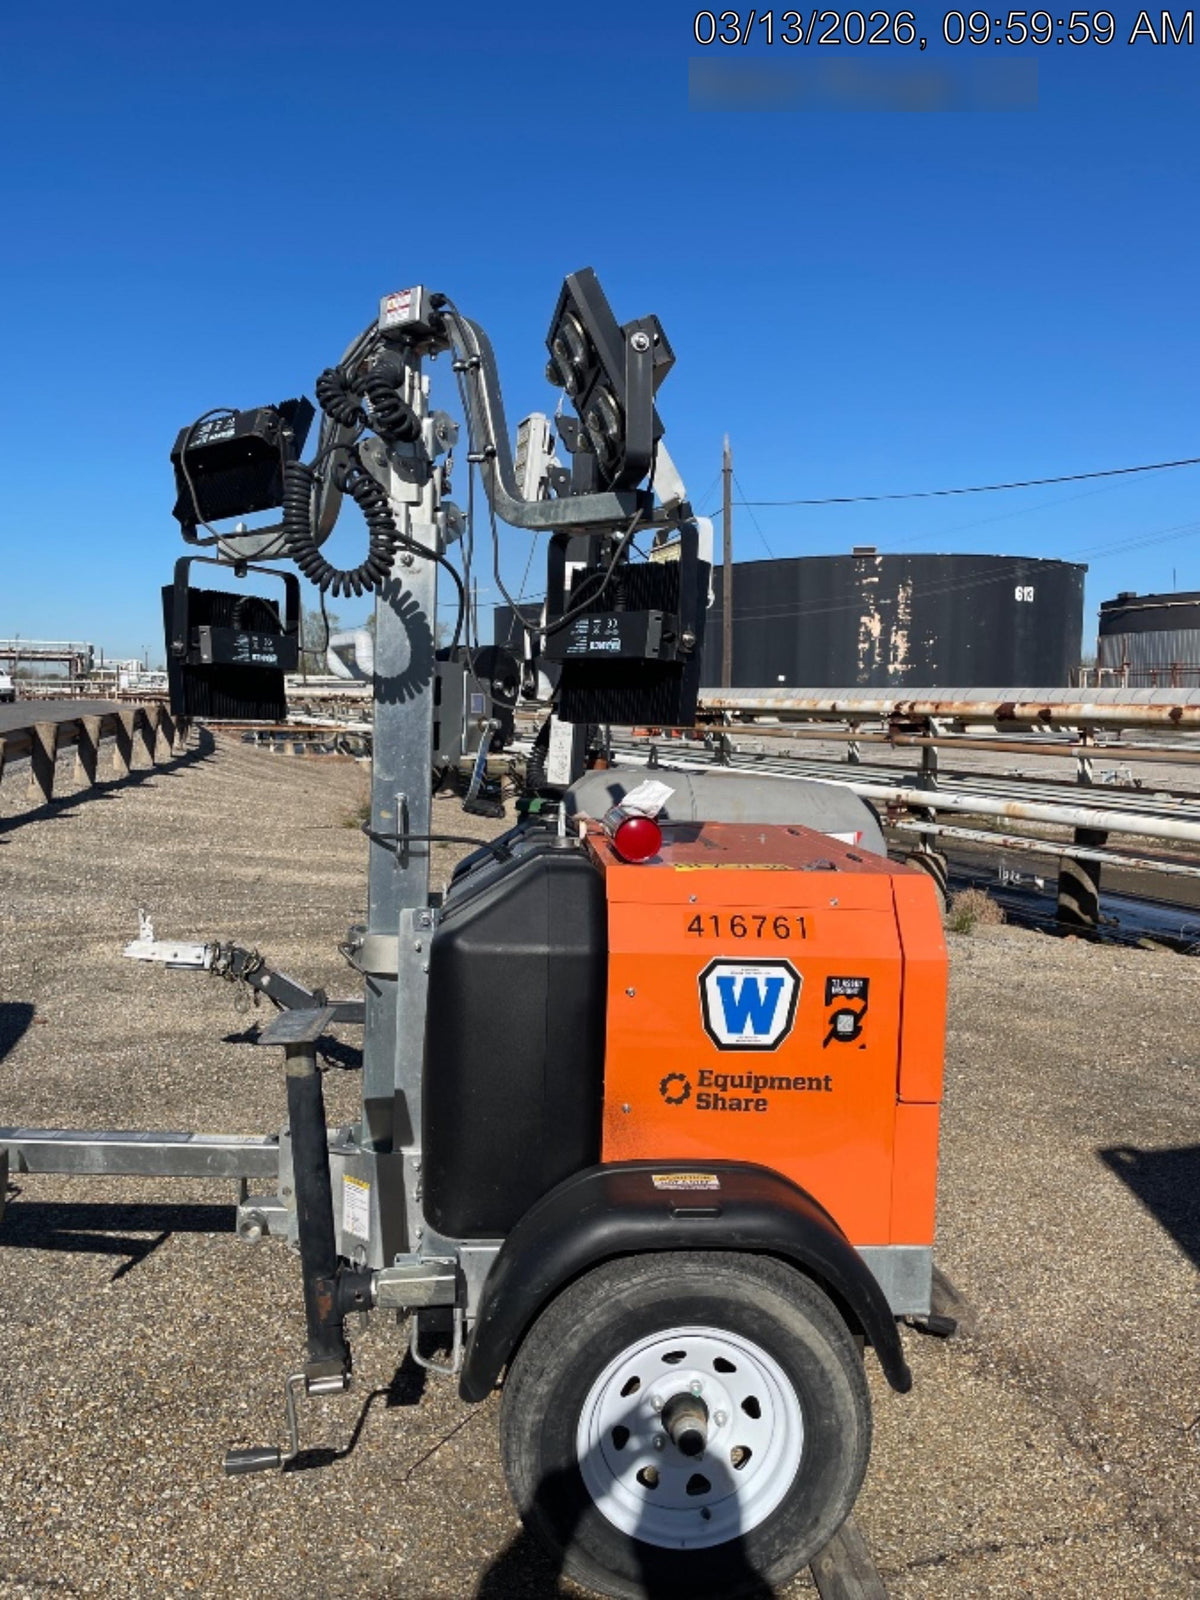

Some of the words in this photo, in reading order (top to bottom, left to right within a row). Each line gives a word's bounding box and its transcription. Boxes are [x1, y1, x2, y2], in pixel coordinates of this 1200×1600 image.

[1015, 586, 1034, 602] 613
[687, 914, 806, 939] 416761
[716, 976, 785, 1035] W
[698, 1069, 832, 1093] Equipment
[696, 1093, 768, 1112] Share
